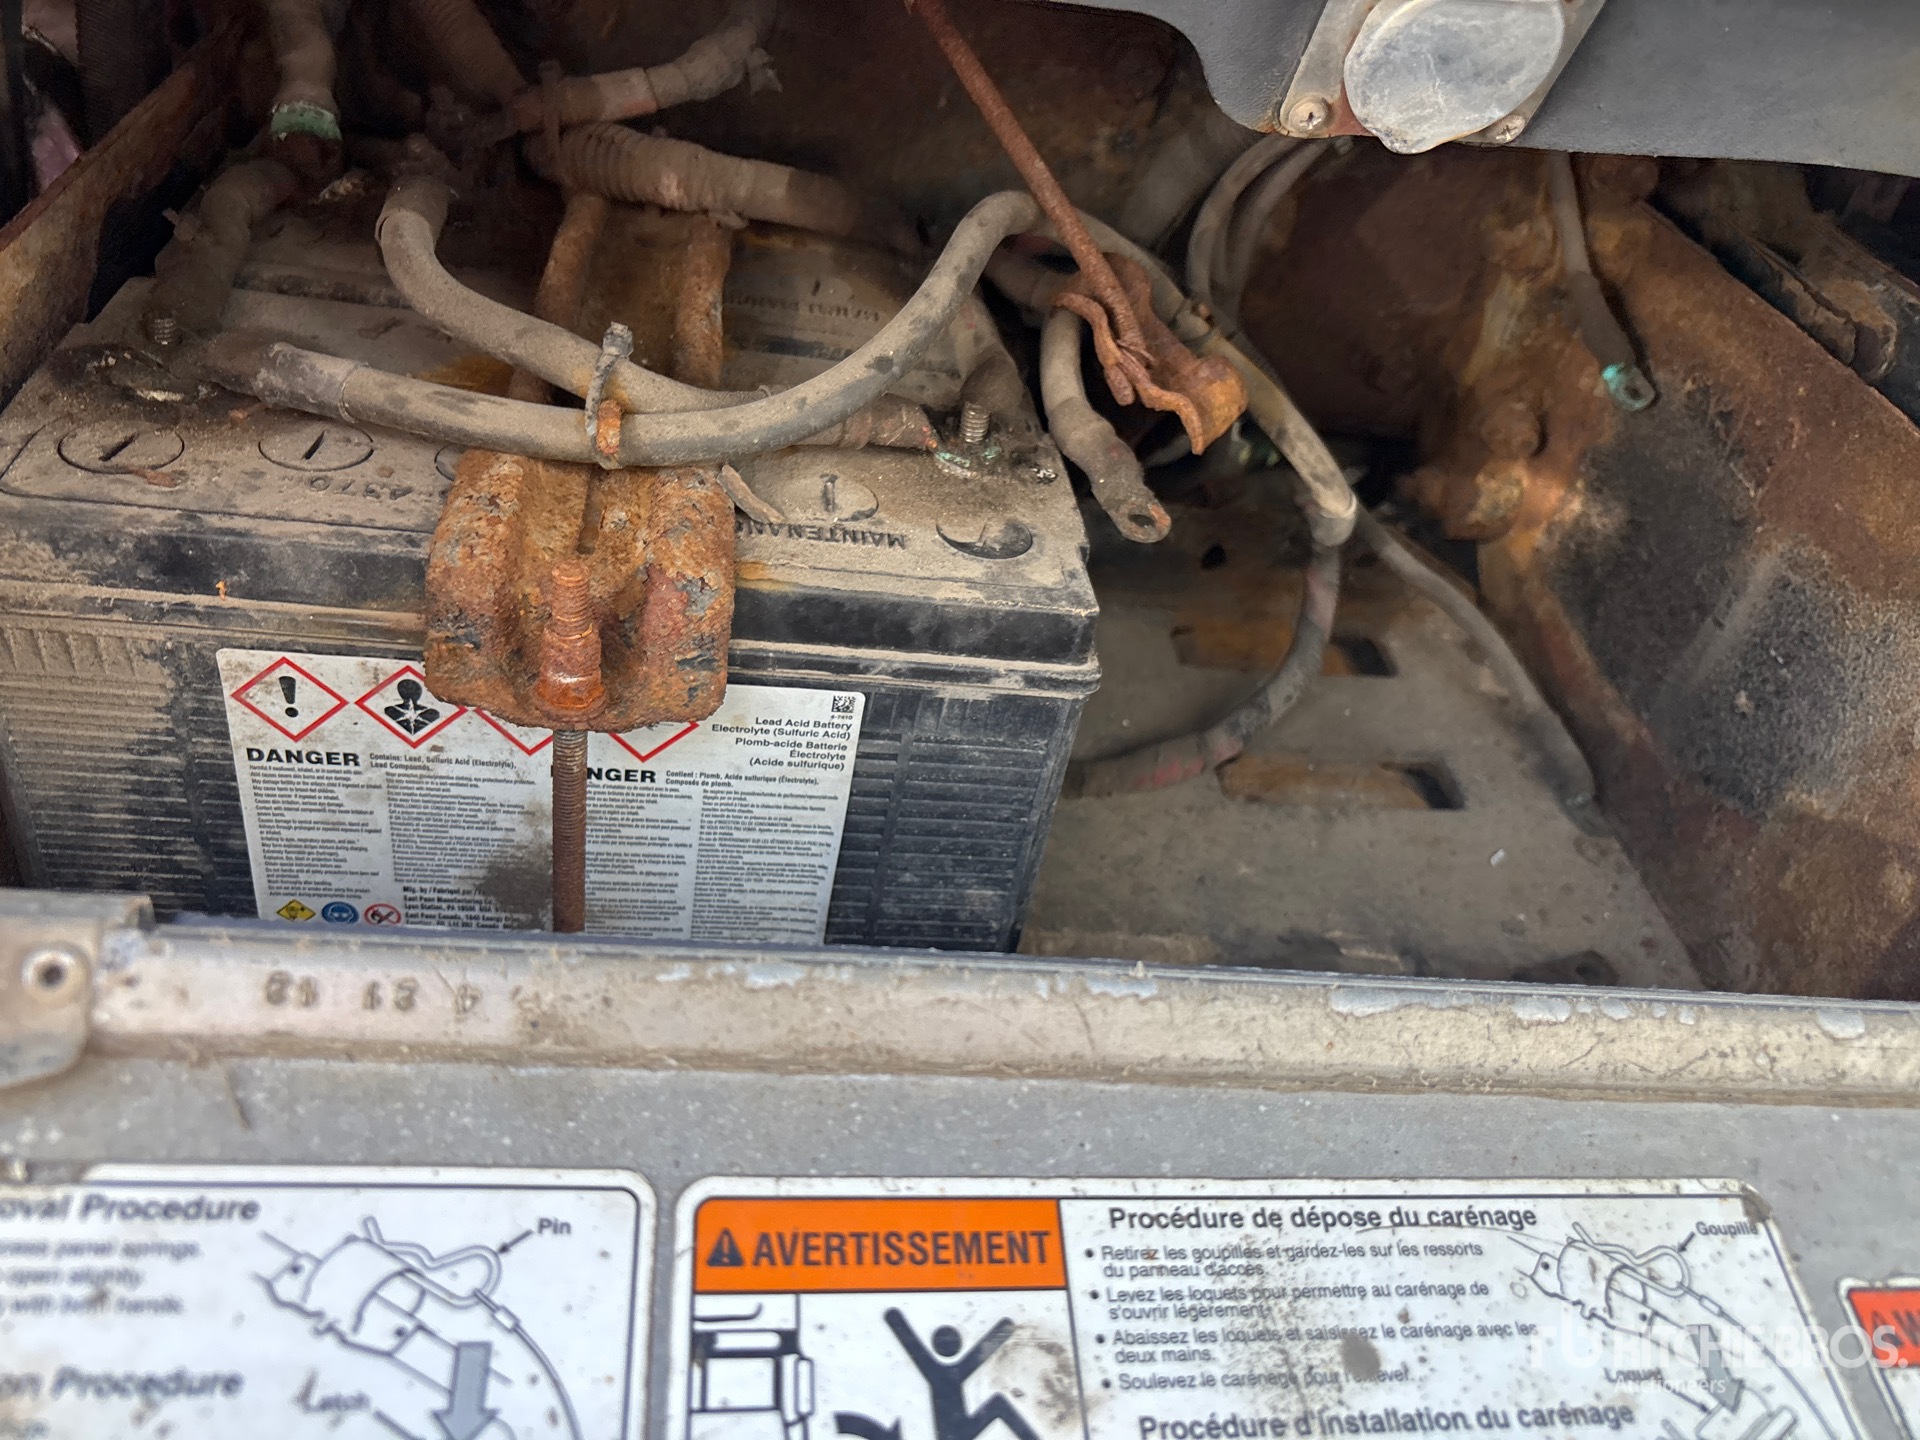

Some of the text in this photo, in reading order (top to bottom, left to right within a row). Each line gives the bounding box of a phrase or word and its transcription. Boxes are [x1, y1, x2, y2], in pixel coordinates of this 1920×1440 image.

[712, 724, 851, 741] Electrolyte (Sulfuric Acid)
[755, 717, 852, 731] Lead Acid Battery
[735, 737, 848, 751] Plomb-acide Batterie
[246, 747, 360, 767] DANGER
[369, 752, 402, 762] Contains:
[454, 758, 470, 766] Acid
[789, 749, 846, 761] Électrolyte
[370, 761, 388, 769] Lead
[749, 757, 845, 772] (Acide sulfurique)
[551, 765, 656, 783] NGER
[666, 770, 694, 779] Contient
[699, 772, 723, 781] Plomb,
[79, 1193, 262, 1223] Procedure
[538, 1217, 572, 1235] Pin
[1109, 1204, 1538, 1233] Procédure de dépose du carénage
[752, 1230, 1051, 1268] AVERTISSEMENT
[1102, 1242, 1484, 1263] Retirez les goupilles et gardez-les sur les ressorts
[1103, 1263, 1124, 1278] du
[1129, 1264, 1200, 1280] panneau
[1107, 1281, 1489, 1303] Levez les loquets pour permettre au carénage de
[1109, 1303, 1168, 1320] s'ouvrir
[1113, 1329, 1189, 1345] Abaissez
[1193, 1328, 1218, 1343] les
[1221, 1327, 1282, 1346] loquets
[1286, 1326, 1300, 1341] et
[1381, 1323, 1396, 1338] le
[1400, 1322, 1472, 1341] carénage
[1476, 1323, 1512, 1339] avec
[1115, 1348, 1215, 1364] deux mains.
[1118, 1372, 1197, 1390] Soulevez
[1201, 1372, 1216, 1386] le
[1139, 1401, 1636, 1440] Procédure d'installation du carénage
